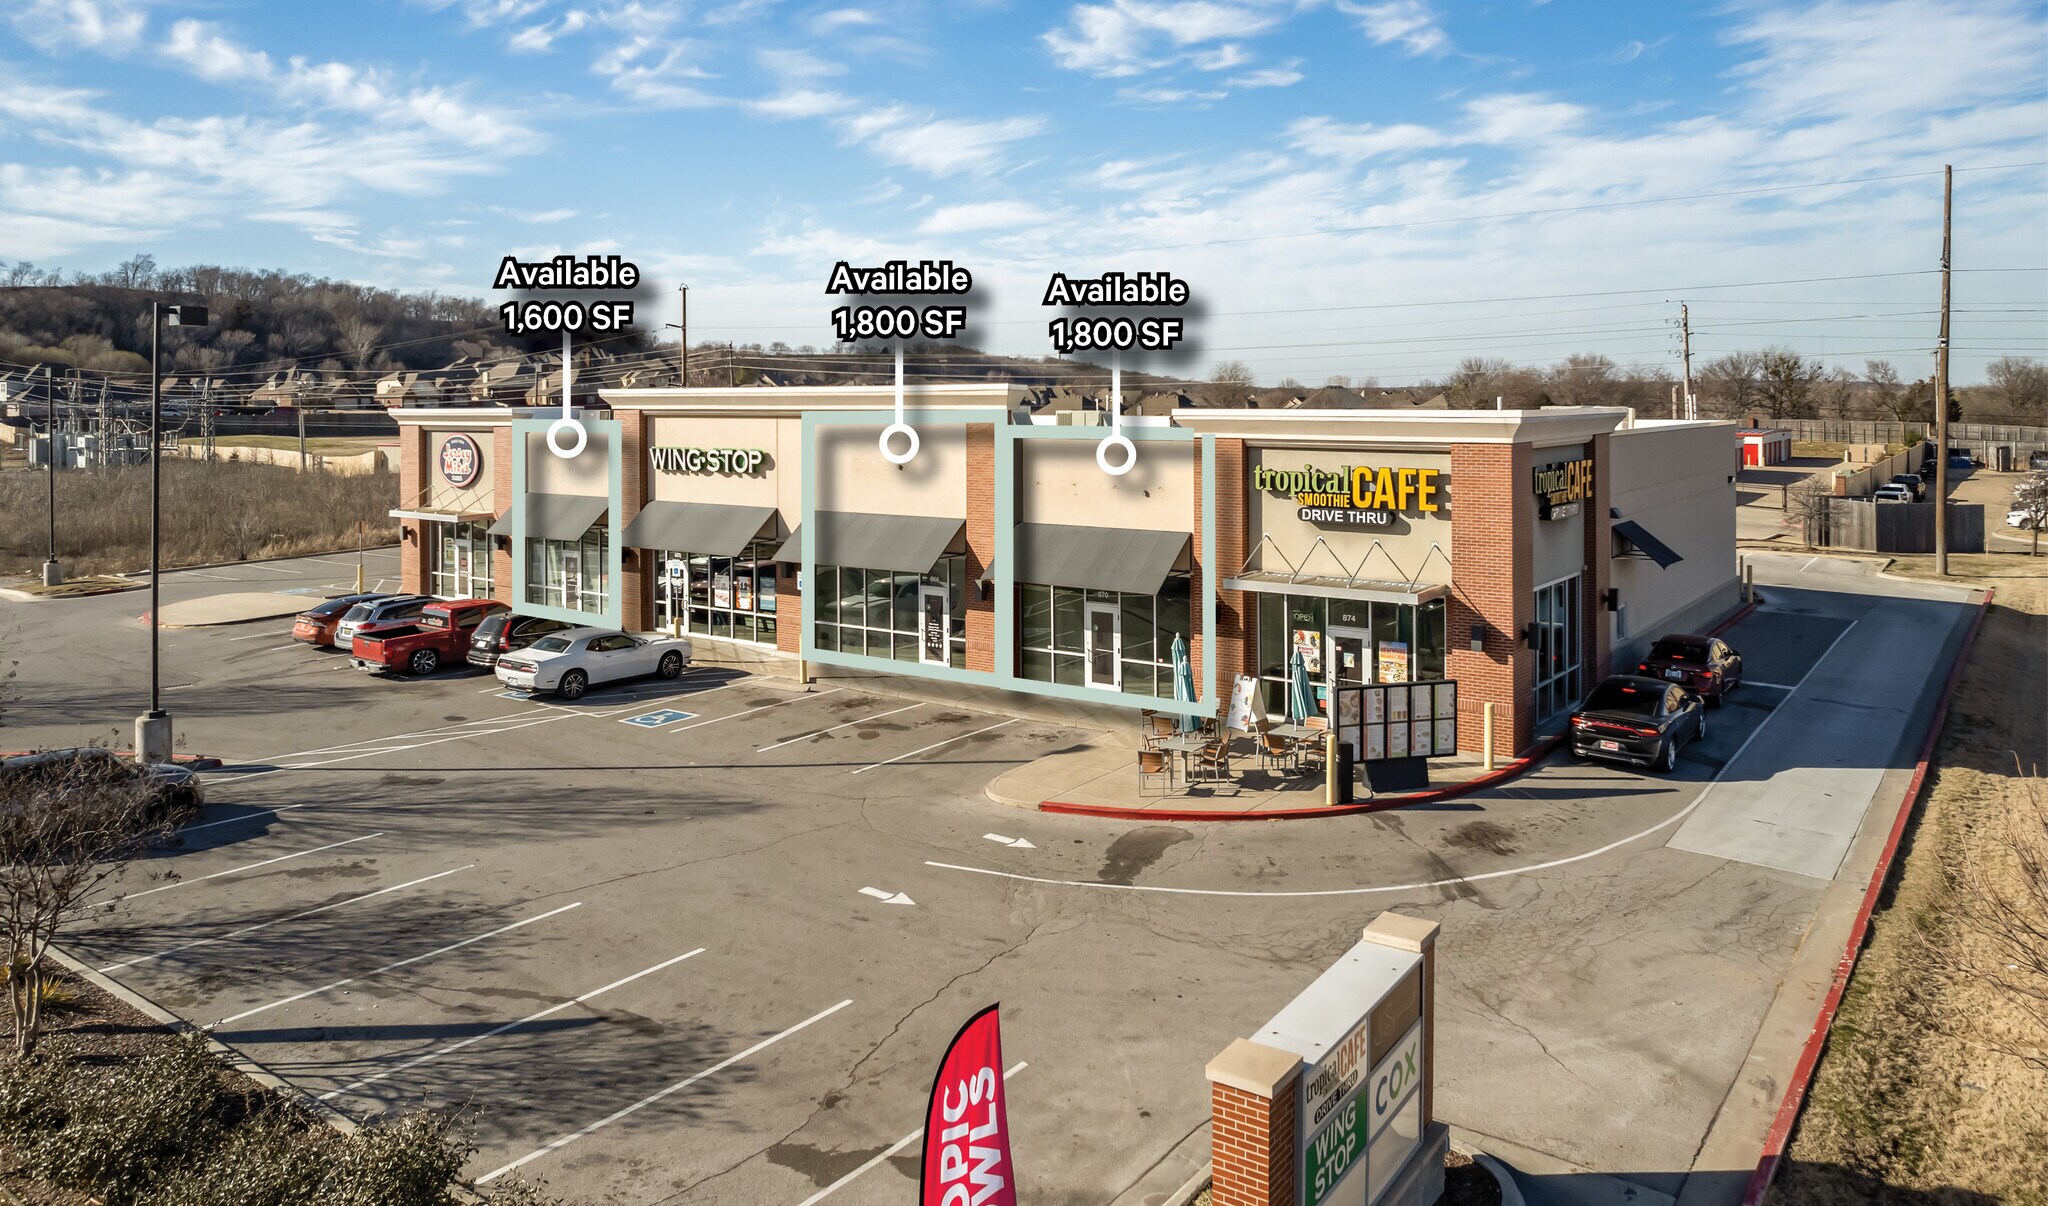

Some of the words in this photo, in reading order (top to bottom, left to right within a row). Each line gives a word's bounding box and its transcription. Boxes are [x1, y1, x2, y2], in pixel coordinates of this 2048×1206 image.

[1254, 464, 1350, 497] tropical
[1352, 466, 1438, 512] CAFE
[1297, 493, 1350, 508] SMOOTHIE
[1535, 462, 1568, 498] tropical
[1567, 459, 1593, 501] CAFE
[1301, 508, 1344, 522] DRIVE
[1346, 511, 1387, 525] THRU
[1293, 612, 1314, 623] OPEN
[1342, 614, 1356, 622] 874
[1305, 1051, 1341, 1104] tropical
[1340, 1023, 1367, 1079] CAFE
[1375, 1041, 1417, 1116] COX
[1316, 1091, 1338, 1124] DRIVE
[1338, 1071, 1358, 1103] THRU
[1315, 1100, 1356, 1166] WING
[1315, 1132, 1356, 1200] STOP
